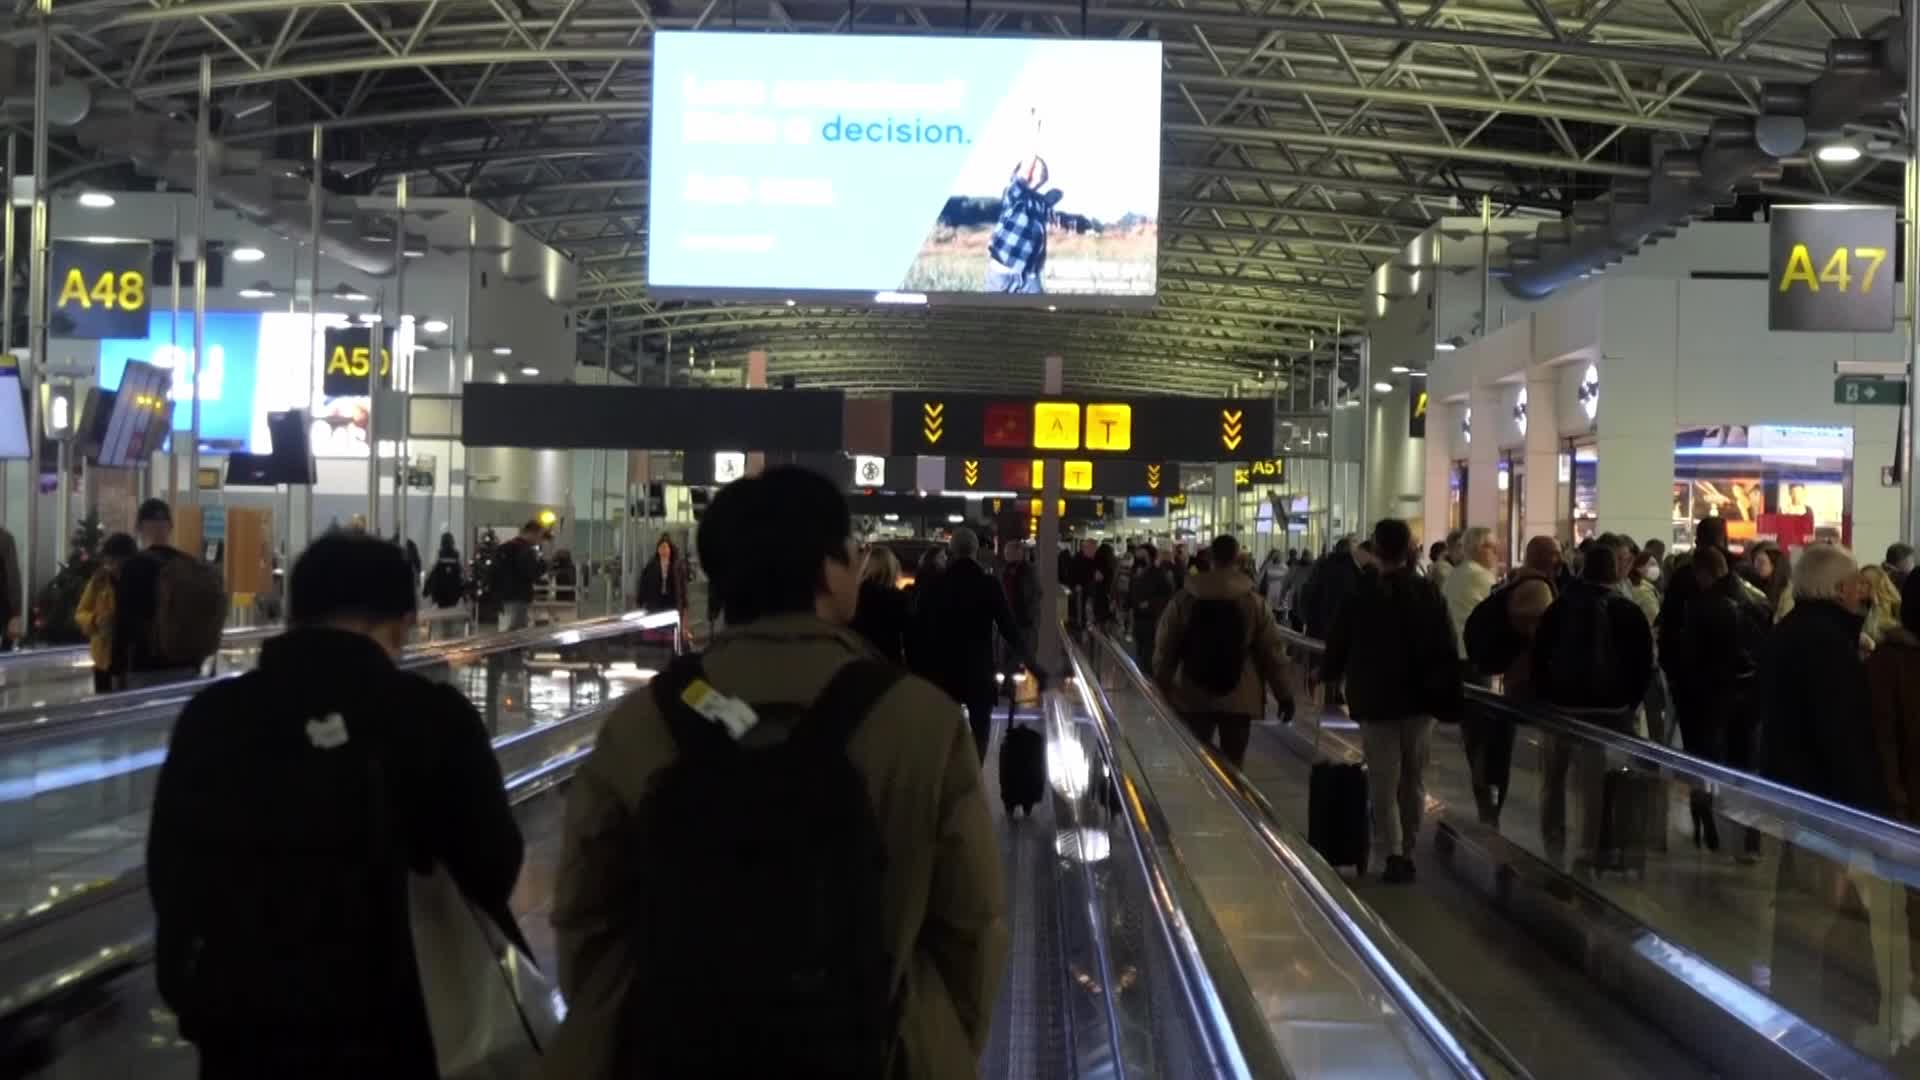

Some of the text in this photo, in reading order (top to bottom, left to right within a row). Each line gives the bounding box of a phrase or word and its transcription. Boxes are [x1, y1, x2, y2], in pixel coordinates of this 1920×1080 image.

[822, 114, 972, 144] decision.
[1780, 244, 1887, 292] A47
[58, 268, 144, 310] A48
[1098, 418, 1118, 445] T
[1072, 470, 1085, 486] T
[1253, 459, 1282, 474] A51
